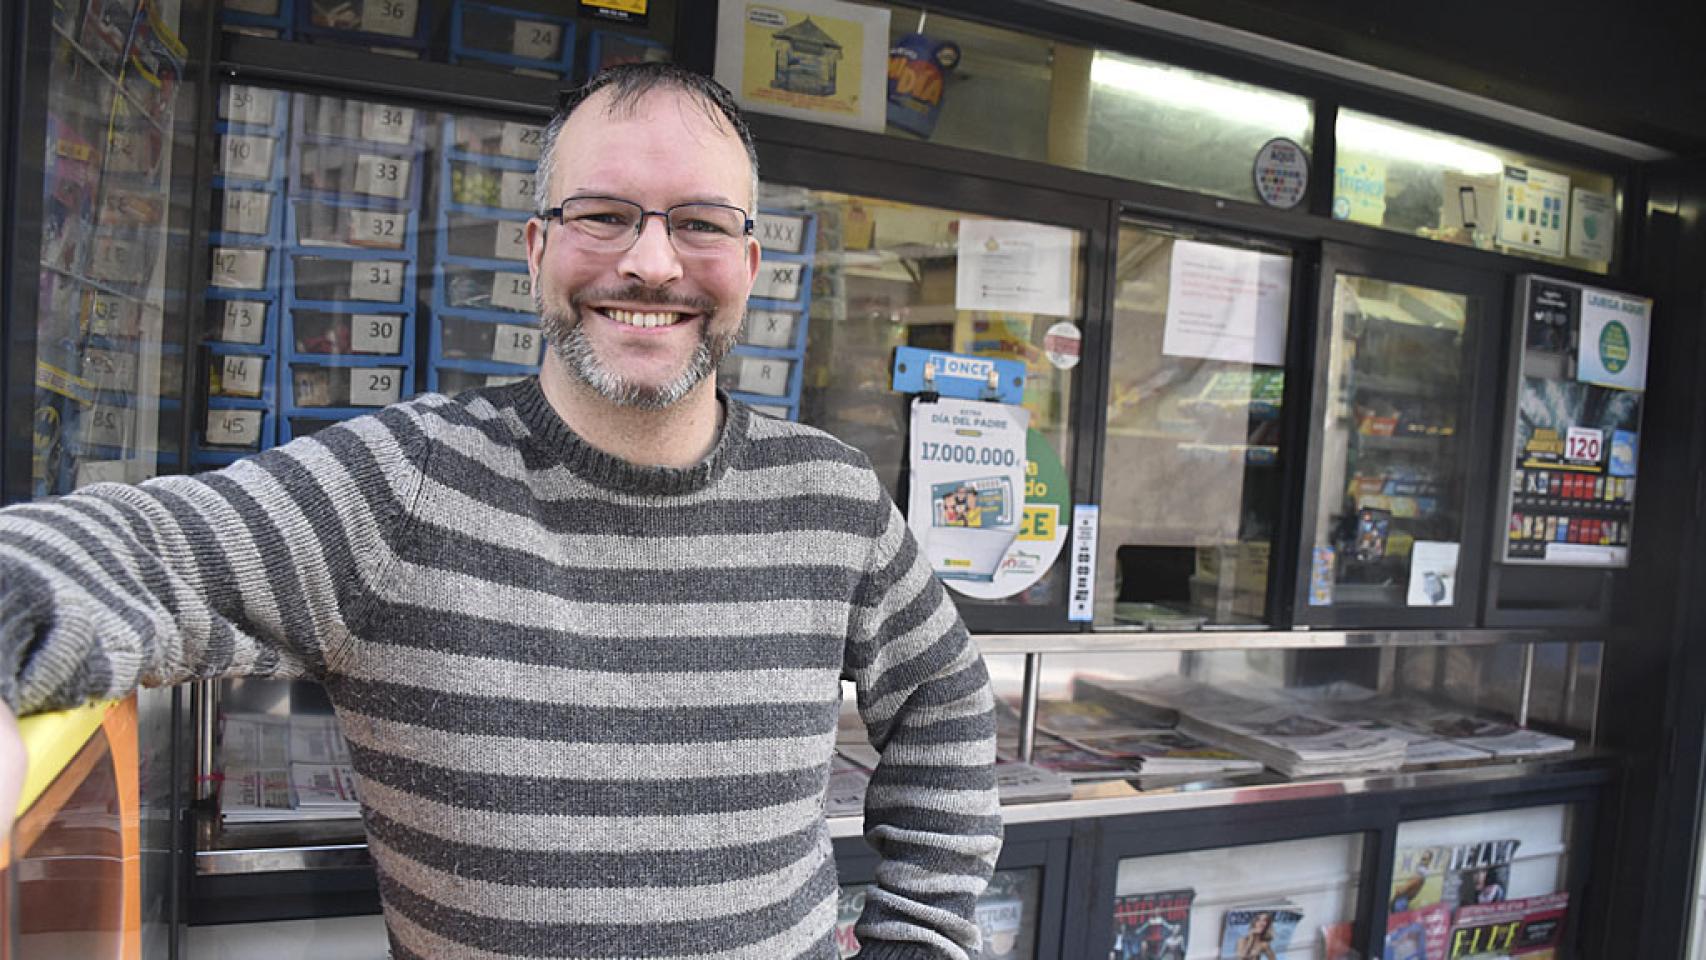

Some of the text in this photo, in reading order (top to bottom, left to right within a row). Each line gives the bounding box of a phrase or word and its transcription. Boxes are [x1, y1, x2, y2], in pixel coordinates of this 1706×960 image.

[382, 2, 404, 19] 36
[530, 29, 551, 45] 24
[233, 92, 253, 111] 39
[381, 110, 403, 127] 34
[519, 129, 540, 146] 22
[228, 138, 250, 160] 40
[375, 163, 398, 181] 33
[373, 220, 395, 237] 32
[763, 222, 794, 243] XXX
[215, 253, 236, 275] 42
[369, 268, 393, 285] 31
[772, 269, 793, 283] XX
[511, 279, 531, 296] 19
[227, 302, 251, 328] 43
[368, 321, 393, 339] 30
[767, 318, 777, 332] X
[512, 333, 533, 350] 18
[226, 360, 247, 383] 44
[760, 365, 771, 380] R
[948, 361, 991, 376] ONCE
[368, 374, 391, 392] 29
[222, 418, 245, 435] 45
[952, 415, 970, 427] DEL
[974, 418, 1008, 430] PADRE
[1569, 436, 1599, 459] 120
[1018, 512, 1050, 537] CE
